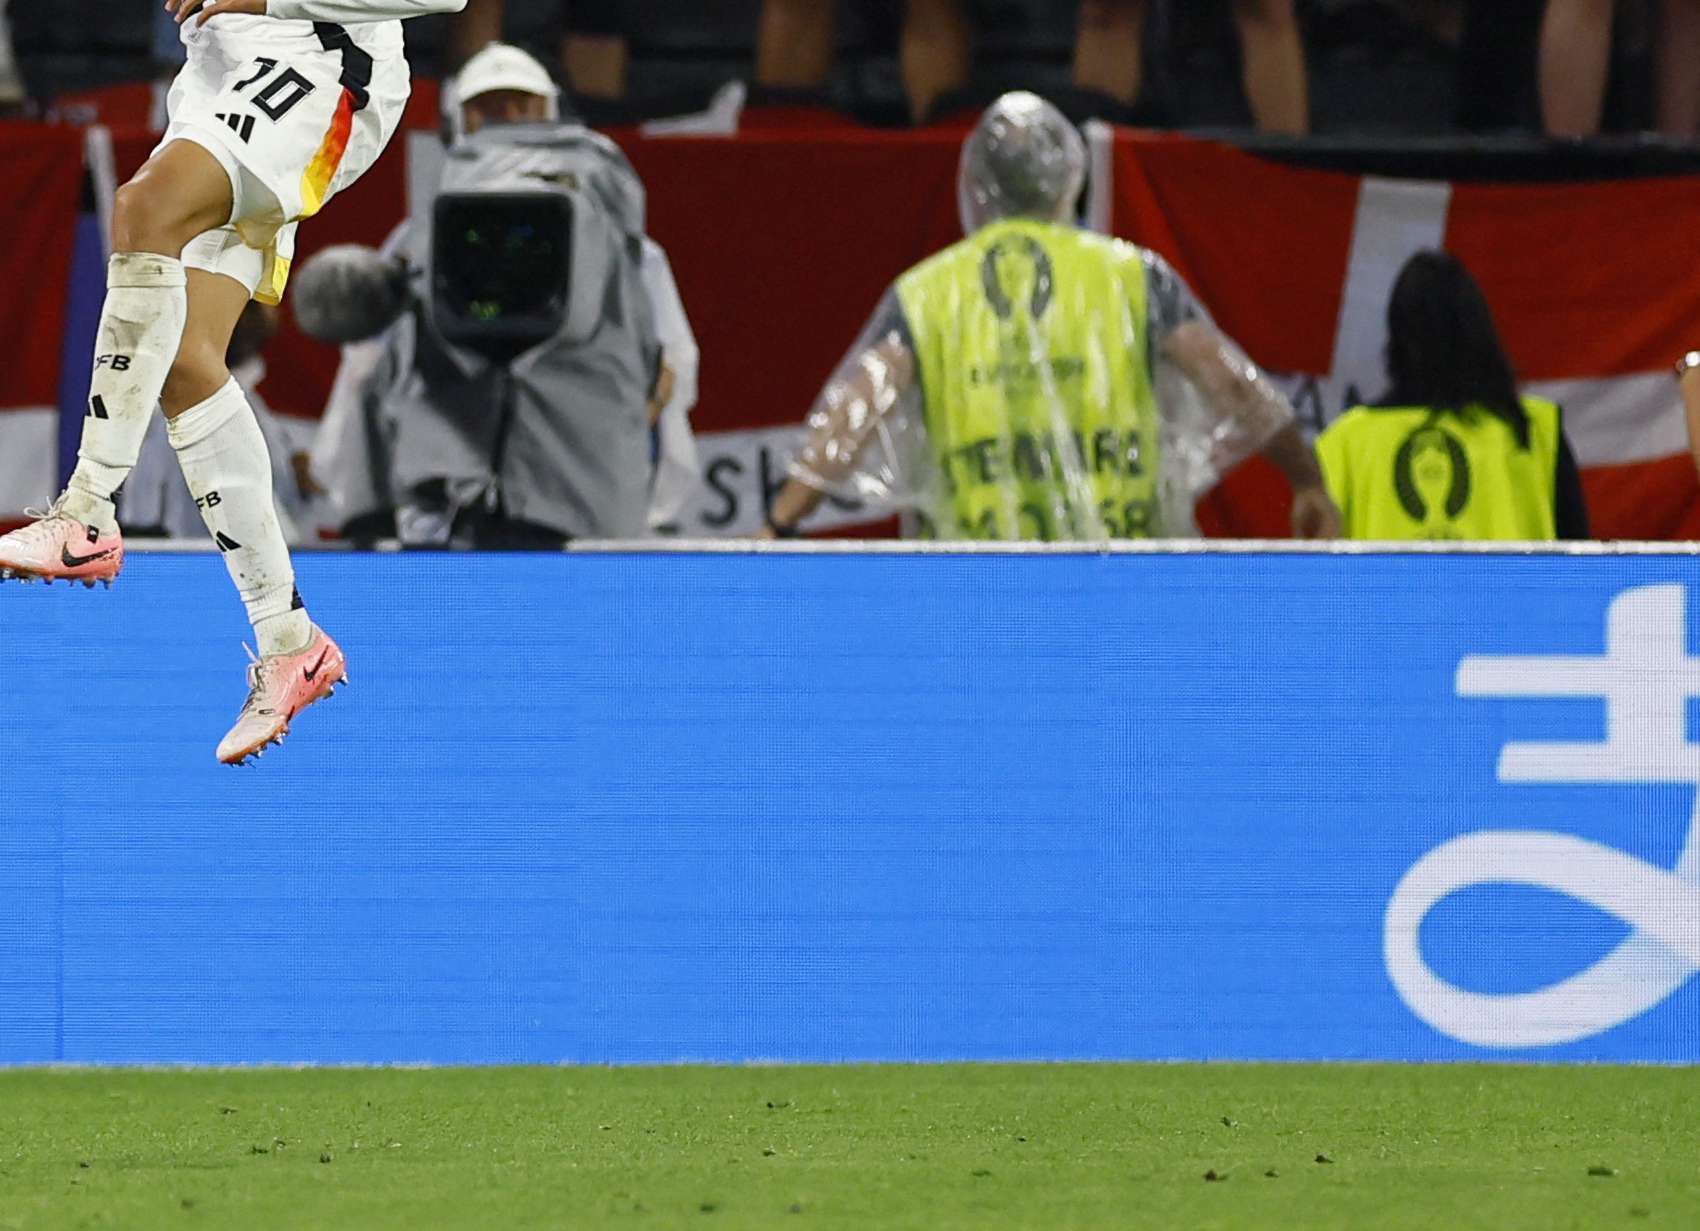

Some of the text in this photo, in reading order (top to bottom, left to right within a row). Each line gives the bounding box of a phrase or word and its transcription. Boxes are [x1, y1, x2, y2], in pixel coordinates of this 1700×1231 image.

[232, 56, 317, 125] 10
[95, 354, 132, 371] FB
[195, 490, 222, 512] FB
